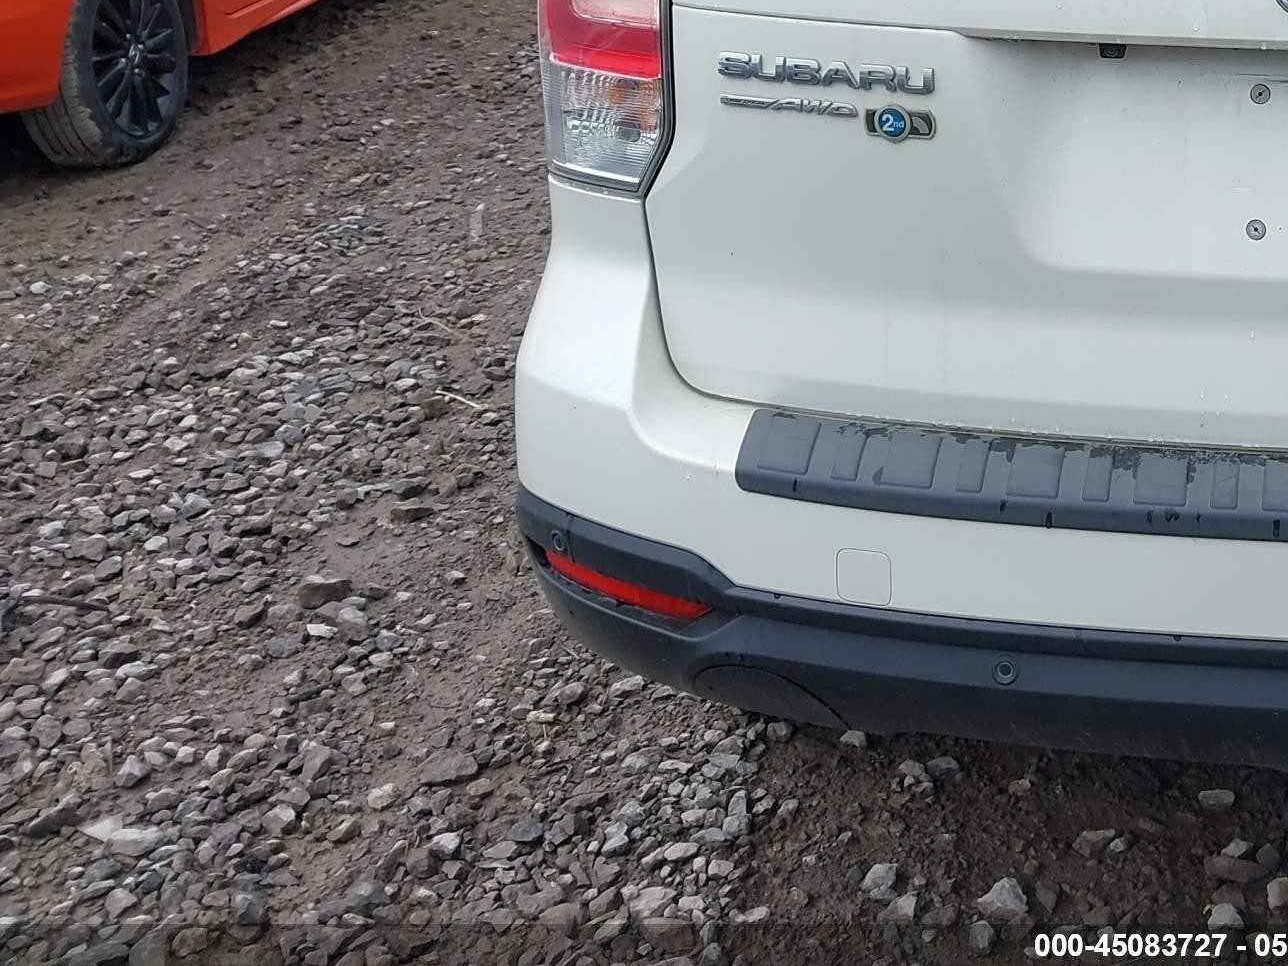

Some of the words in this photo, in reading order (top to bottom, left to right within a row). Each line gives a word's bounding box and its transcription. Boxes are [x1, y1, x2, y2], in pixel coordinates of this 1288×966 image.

[717, 50, 936, 95] SUBARU
[771, 97, 859, 118] AWD
[881, 113, 905, 132] 2nd
